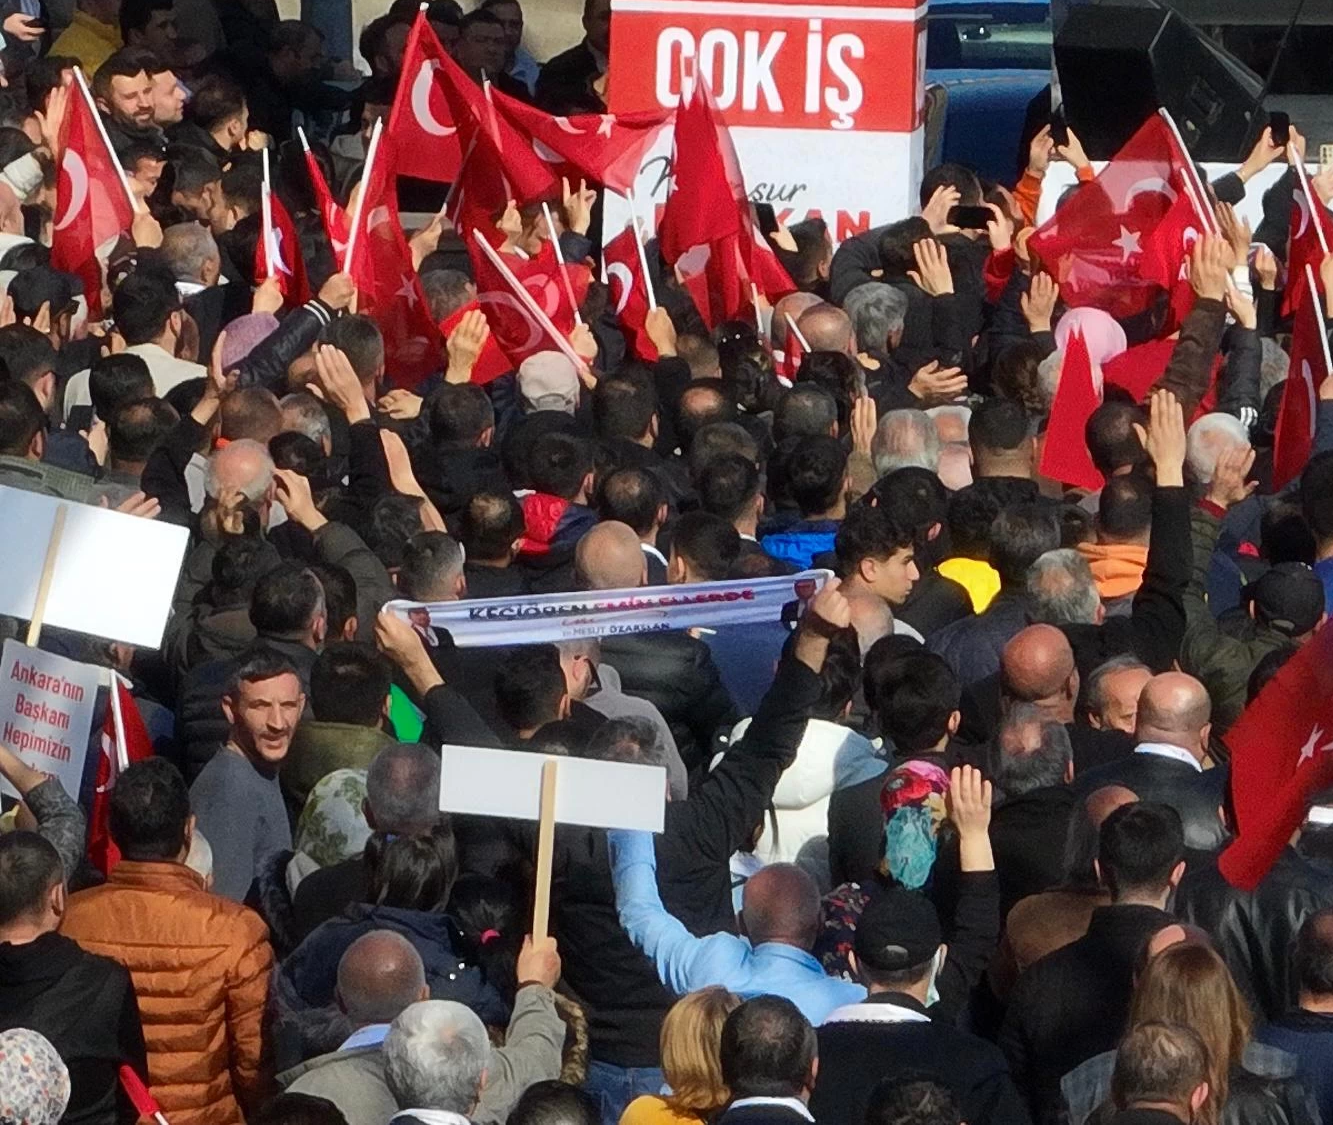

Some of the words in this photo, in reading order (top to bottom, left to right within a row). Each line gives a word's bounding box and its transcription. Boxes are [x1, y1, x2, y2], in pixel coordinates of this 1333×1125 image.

[804, 18, 866, 130] İŞ
[10, 659, 86, 703] Ankara'nın
[15, 692, 71, 731] Başkanı
[3, 721, 72, 763] Hepimizin
